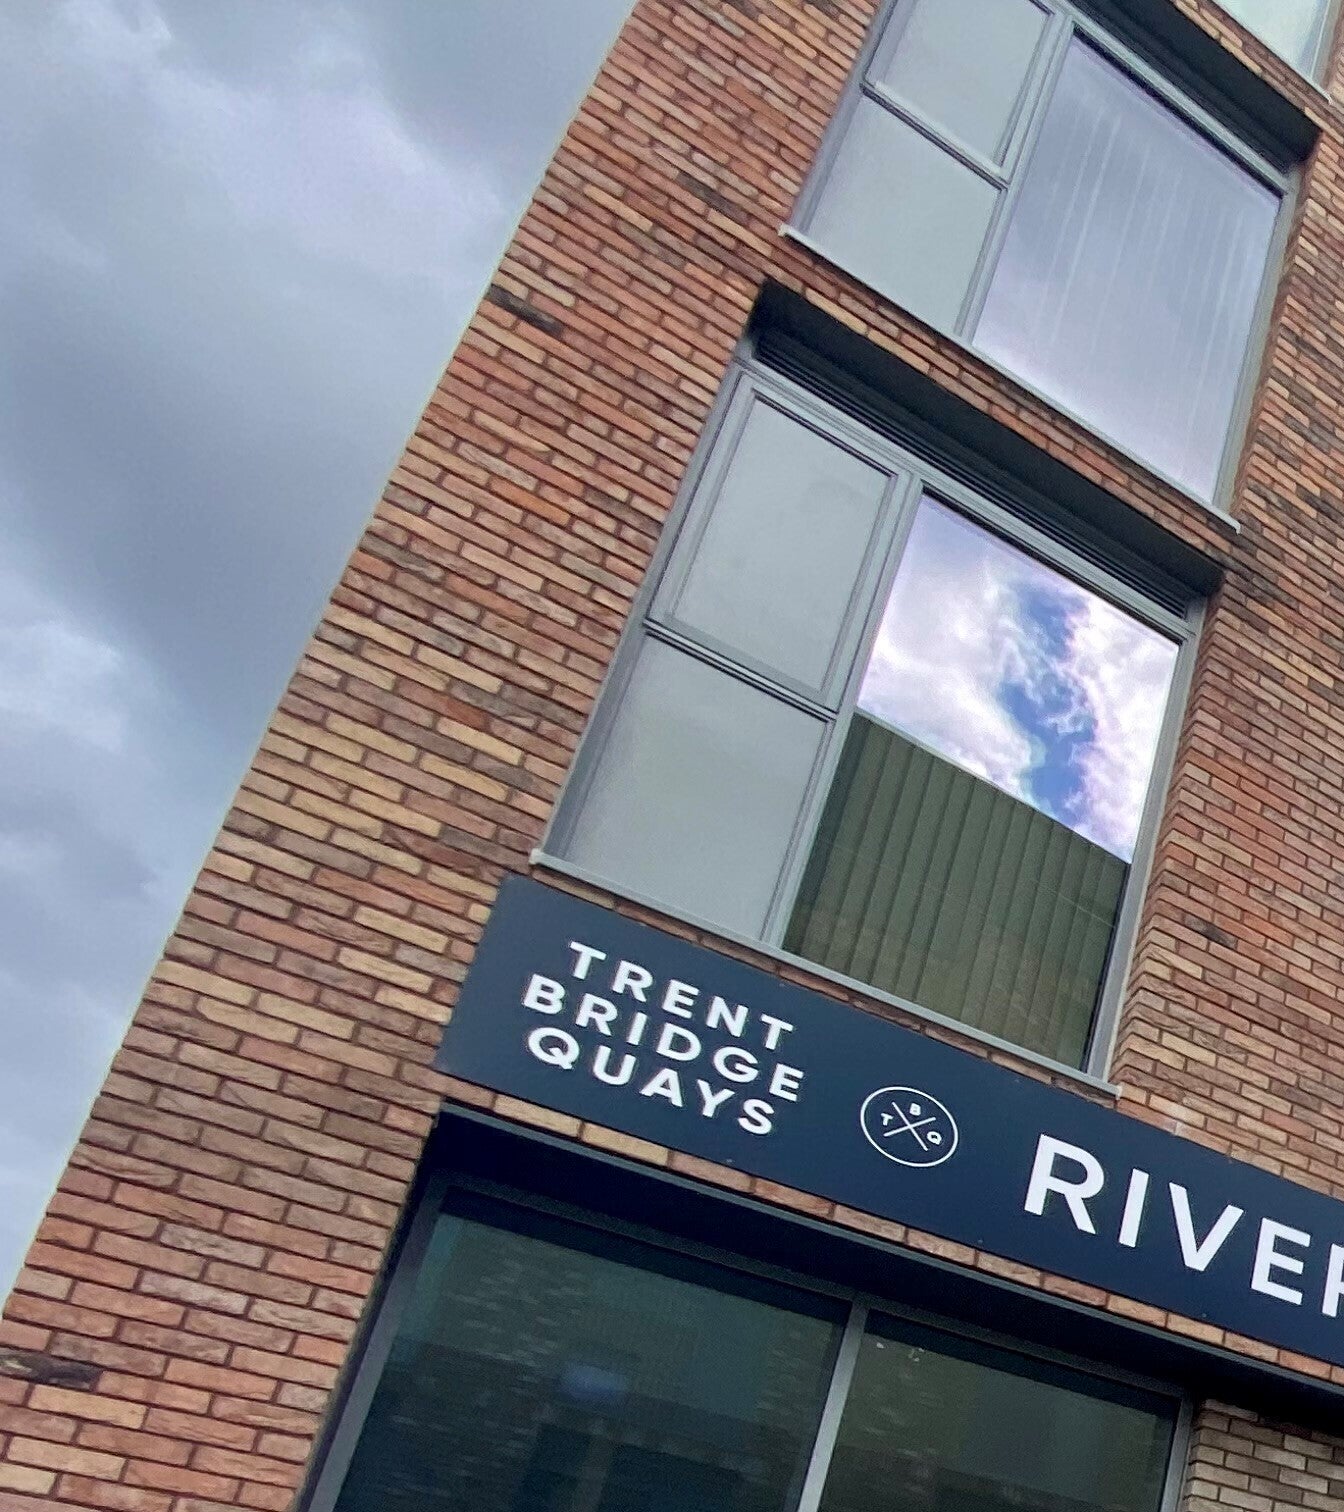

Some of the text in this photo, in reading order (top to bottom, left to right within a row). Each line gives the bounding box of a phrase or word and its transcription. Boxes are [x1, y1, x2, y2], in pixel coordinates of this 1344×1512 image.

[522, 973, 804, 1102] BRIDGE
[570, 941, 794, 1050] TRENT
[527, 1027, 775, 1135] QUAYS
